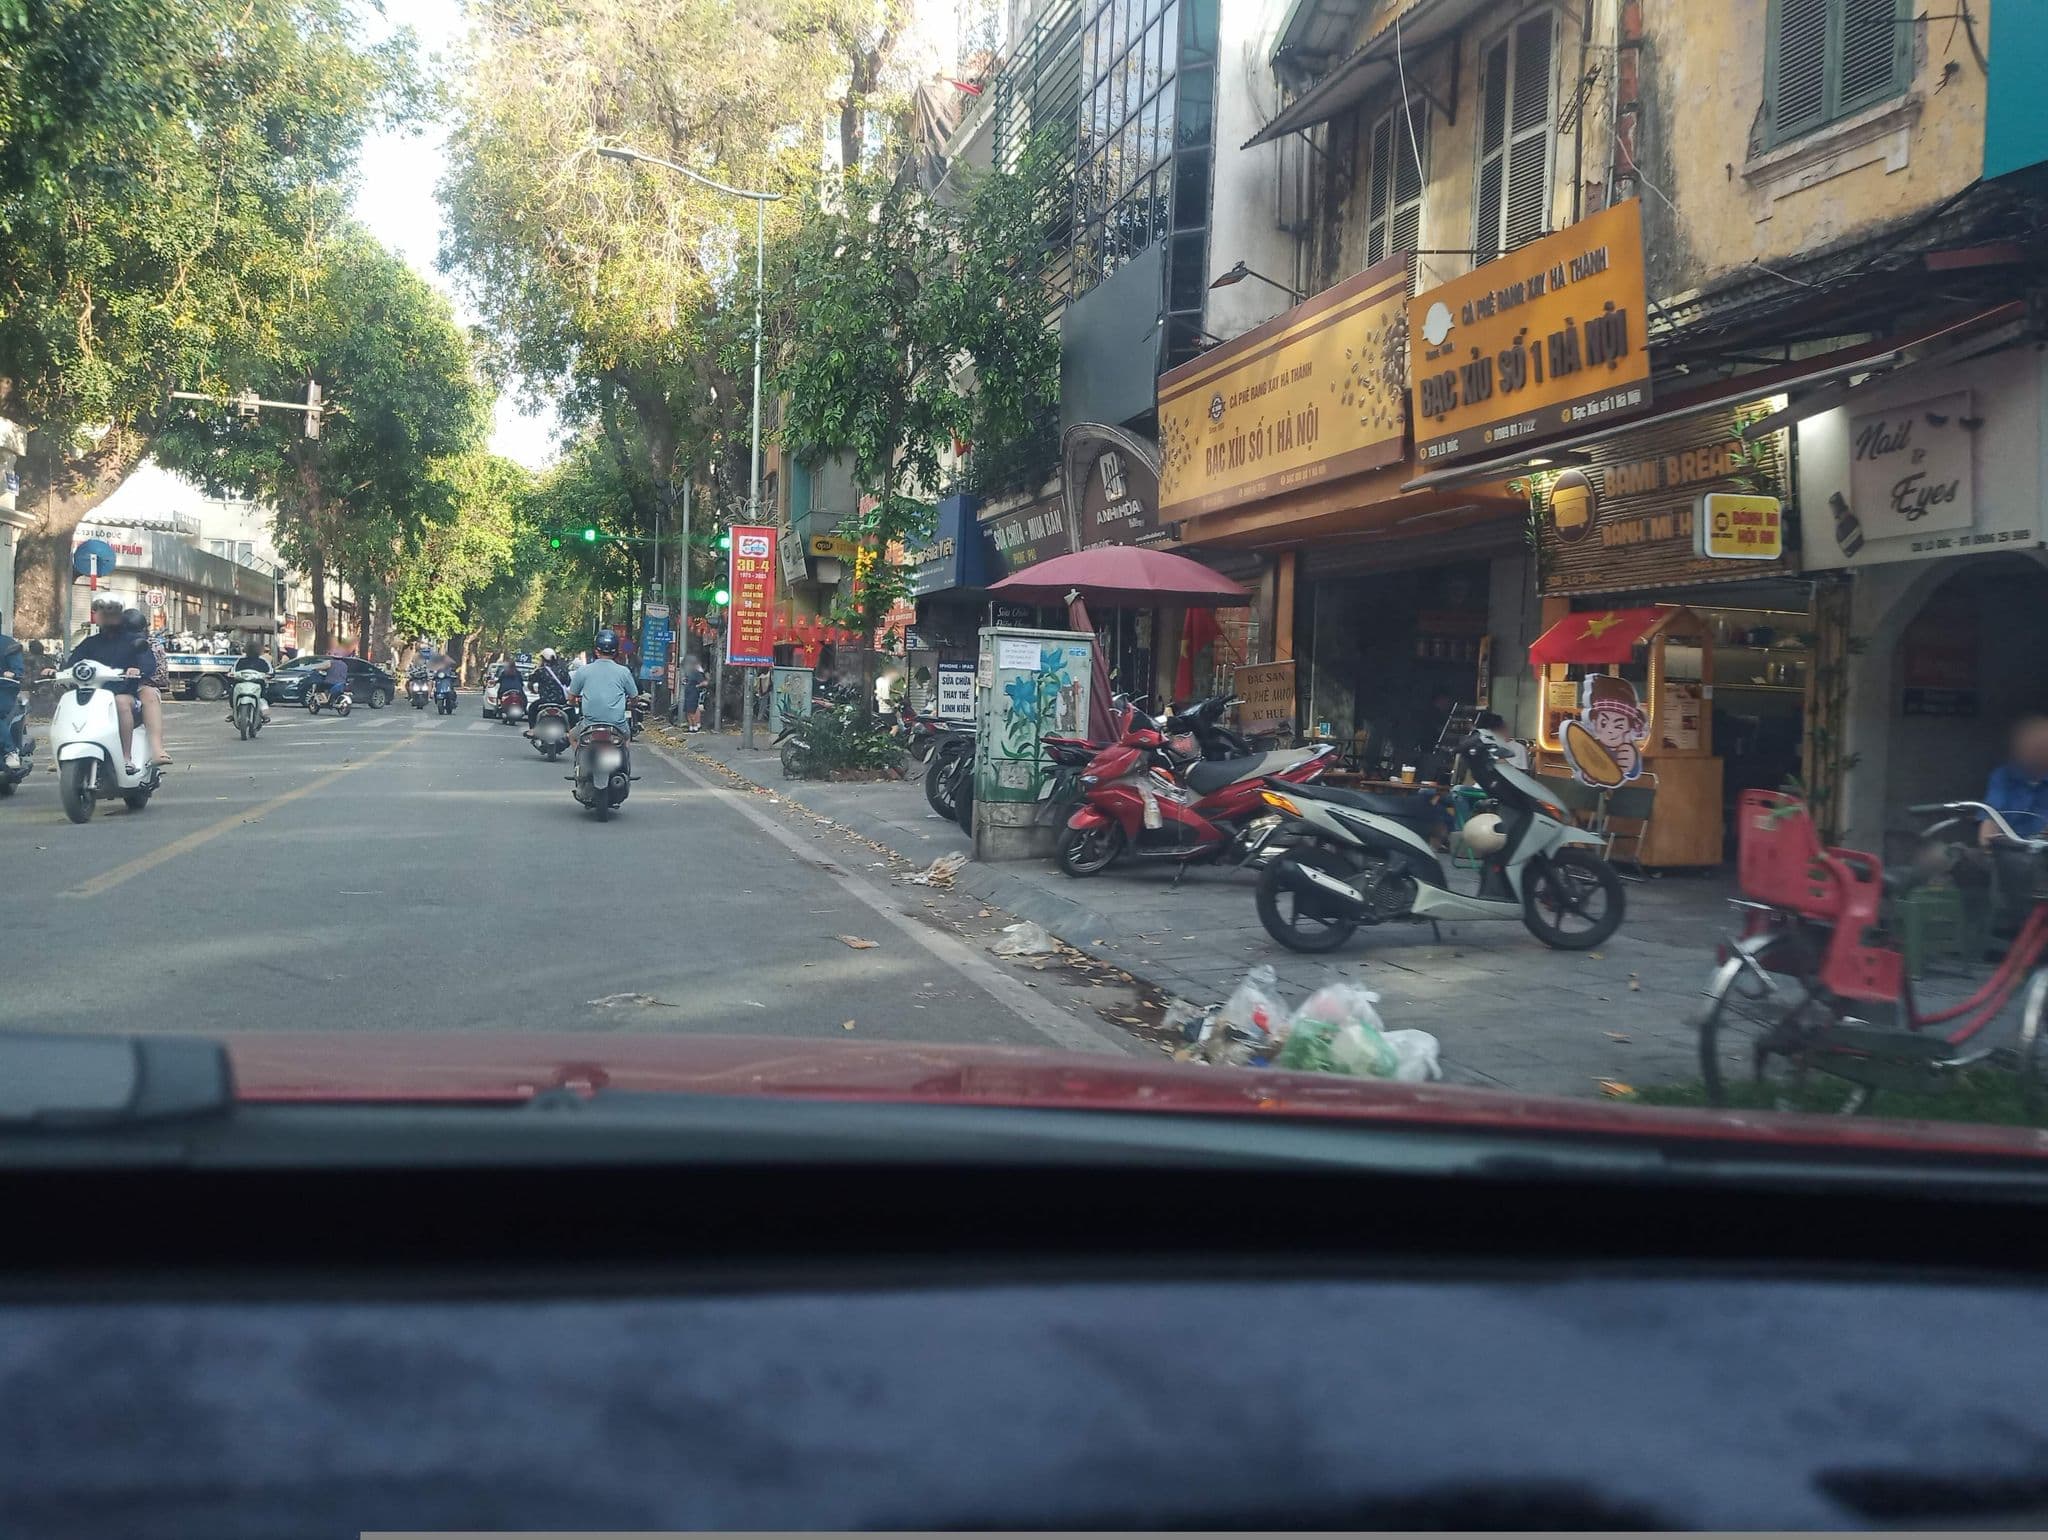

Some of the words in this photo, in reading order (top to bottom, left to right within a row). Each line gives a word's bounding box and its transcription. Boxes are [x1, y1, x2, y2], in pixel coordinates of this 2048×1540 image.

[1420, 370, 1458, 422] BẠC
[1498, 327, 1527, 393] SỐ
[1530, 340, 1543, 383] 1
[1548, 317, 1582, 378] HÀ
[1584, 300, 1628, 370] NỘI
[1206, 443, 1226, 480] BẠC
[1249, 415, 1264, 461] SỐ
[1267, 424, 1273, 456] 1
[1277, 410, 1293, 453] HÀ
[1297, 402, 1318, 451] NỘI
[1856, 419, 1912, 461] Nail
[1603, 460, 1658, 497] BAMI
[1891, 471, 1960, 521] Eyes
[993, 523, 1008, 551] SỬA
[1027, 515, 1047, 541] MUA
[1044, 507, 1063, 536] BÁN
[942, 704, 955, 713] LINH
[956, 702, 971, 715] KIỆN
[943, 690, 958, 700] THAY
[959, 688, 970, 700] THẾ
